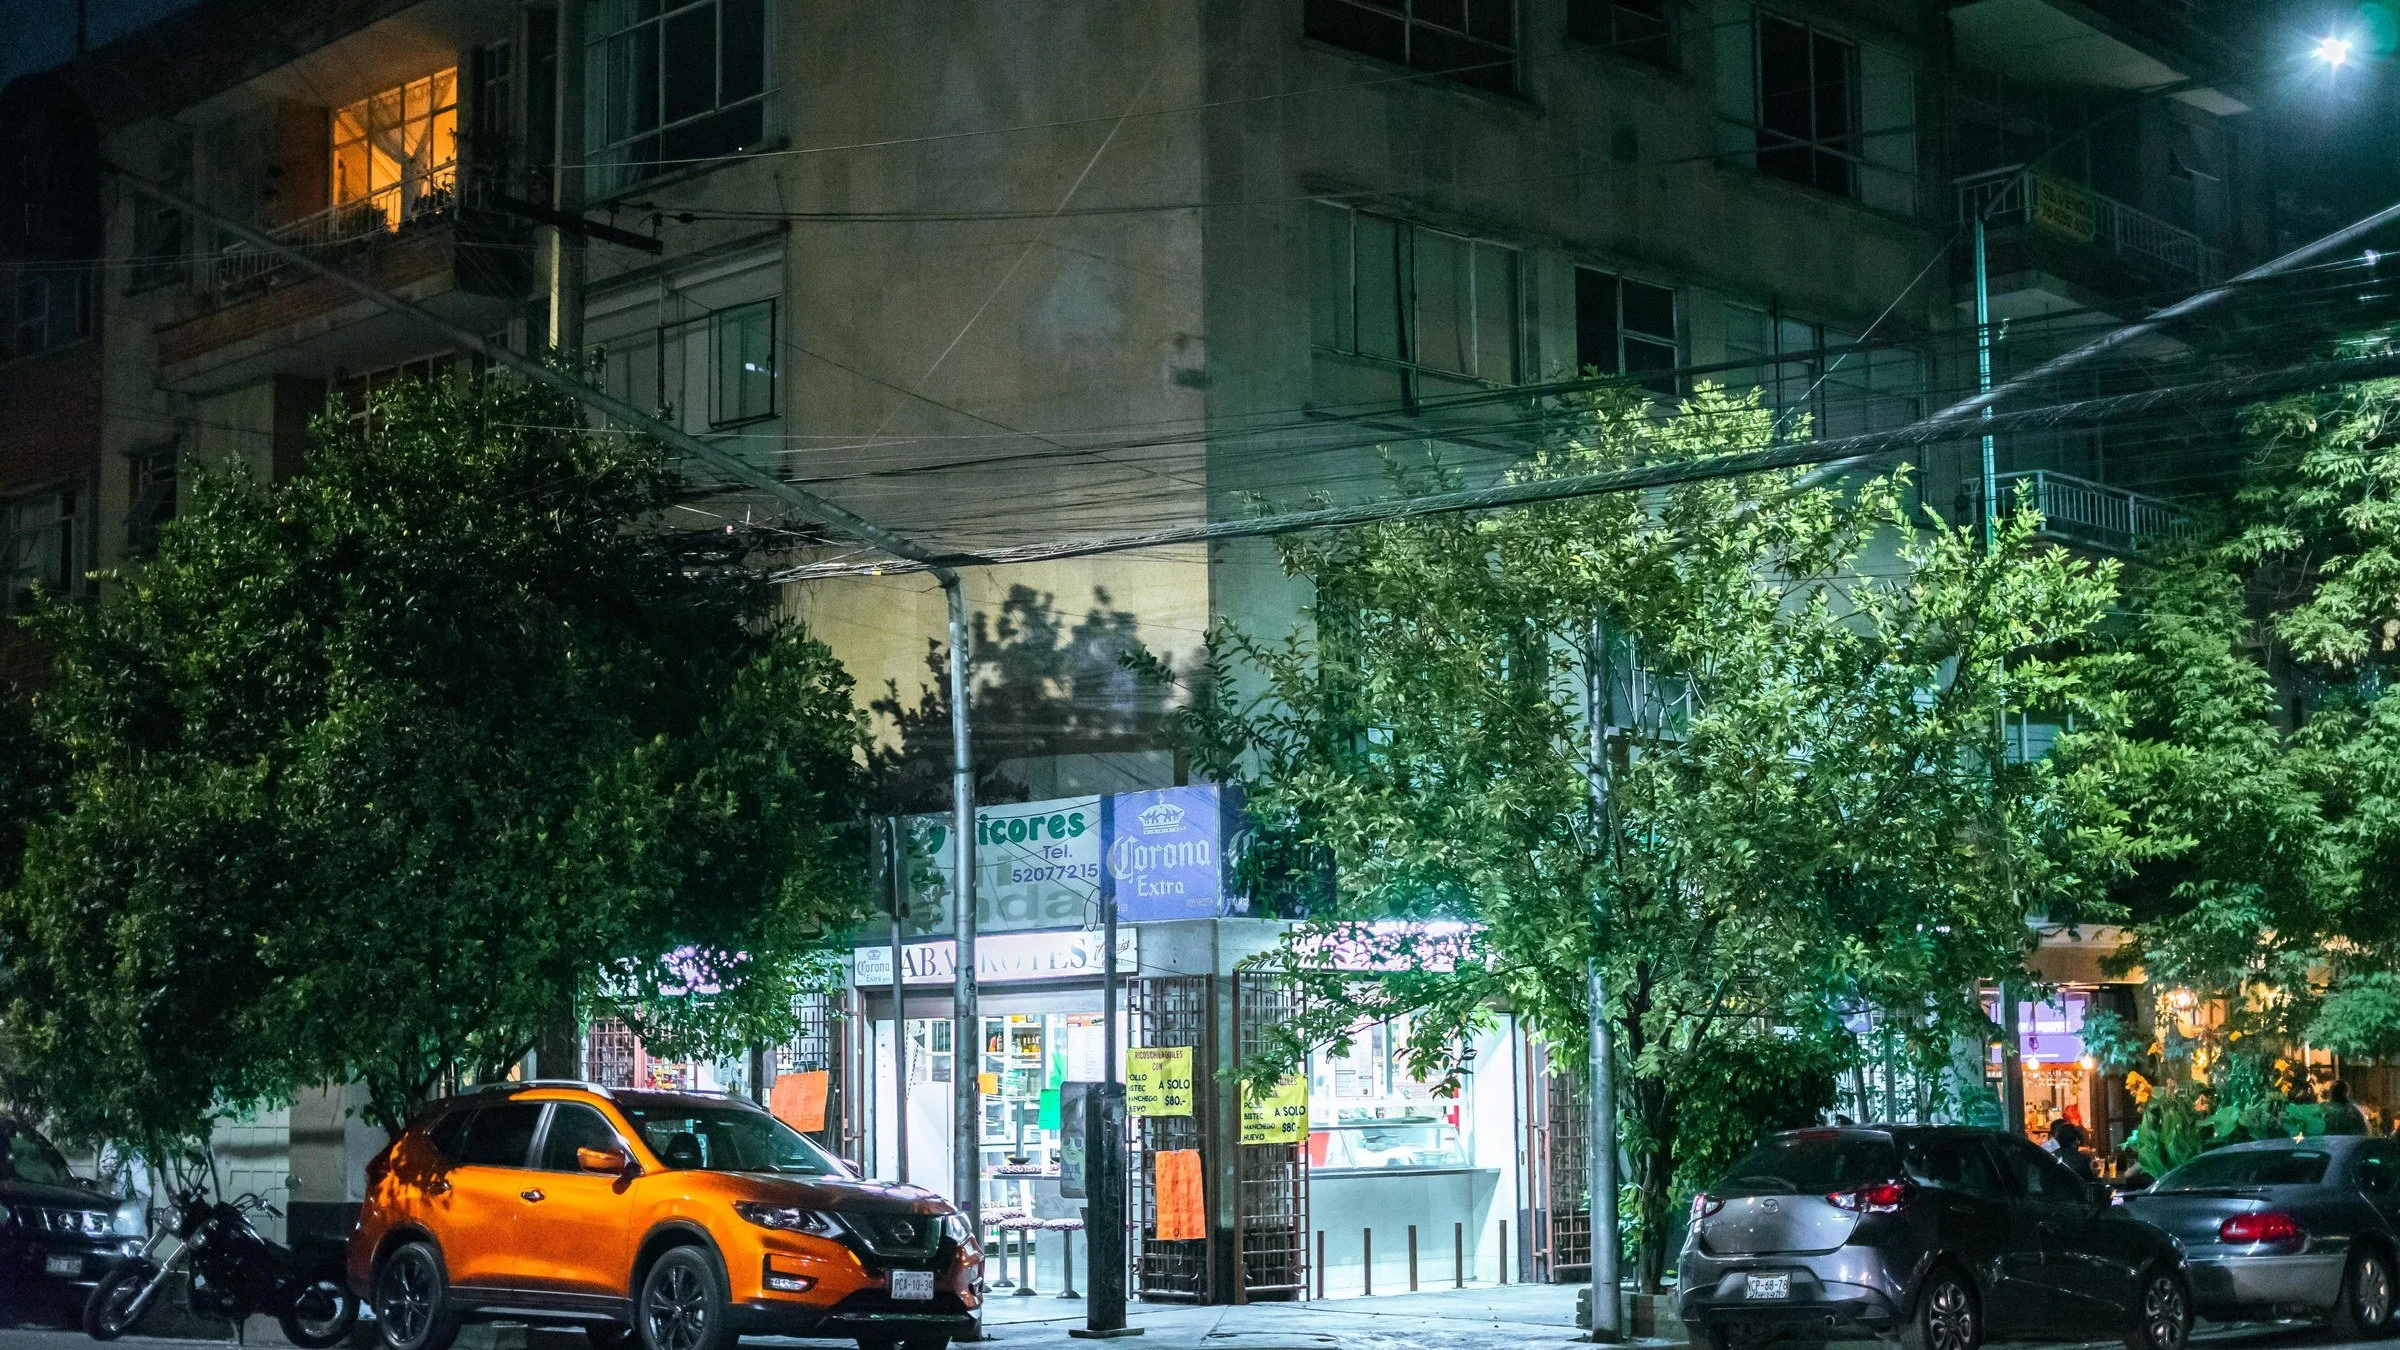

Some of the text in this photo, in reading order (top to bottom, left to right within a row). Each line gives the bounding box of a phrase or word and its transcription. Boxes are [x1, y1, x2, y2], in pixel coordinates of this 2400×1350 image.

[979, 812, 1085, 845] icores
[1042, 844, 1073, 859] Tel.
[1106, 834, 1212, 884] Corona
[1012, 863, 1099, 883] 52077215
[1136, 874, 1185, 897] Extra
[857, 960, 890, 977] Corona
[1158, 1079, 1190, 1090] A SOLO
[1274, 1105, 1306, 1117] A SOLO
[1244, 1122, 1276, 1130] MANCHEGO
[1243, 1133, 1265, 1141] HUEVO
[1746, 1290, 1786, 1299] Picacho
